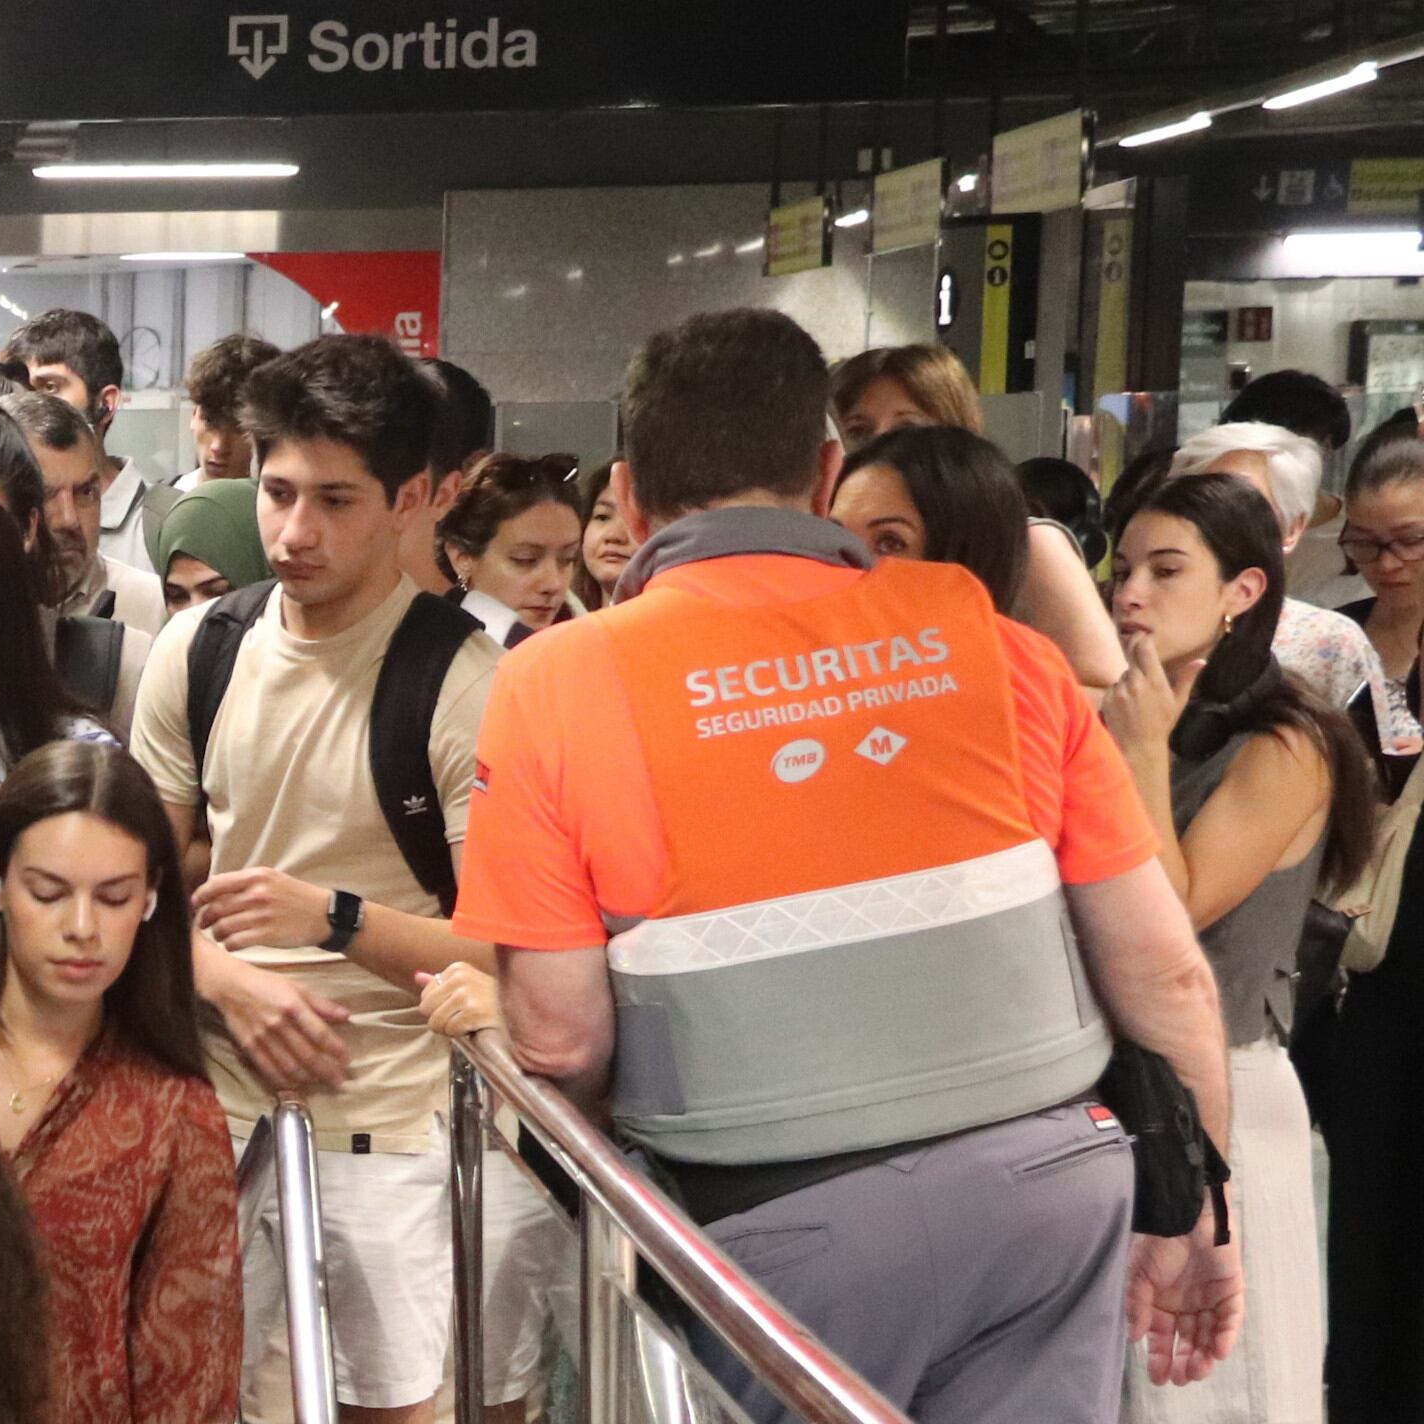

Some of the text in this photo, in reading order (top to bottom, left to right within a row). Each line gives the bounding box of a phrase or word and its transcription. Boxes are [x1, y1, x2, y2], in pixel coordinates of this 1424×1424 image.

[307, 17, 538, 73] Sortida
[685, 627, 949, 707] SECURITAS
[695, 672, 959, 739] SEGURIDAD PRIVADA
[784, 752, 817, 769] TMB
[869, 735, 893, 757] M
